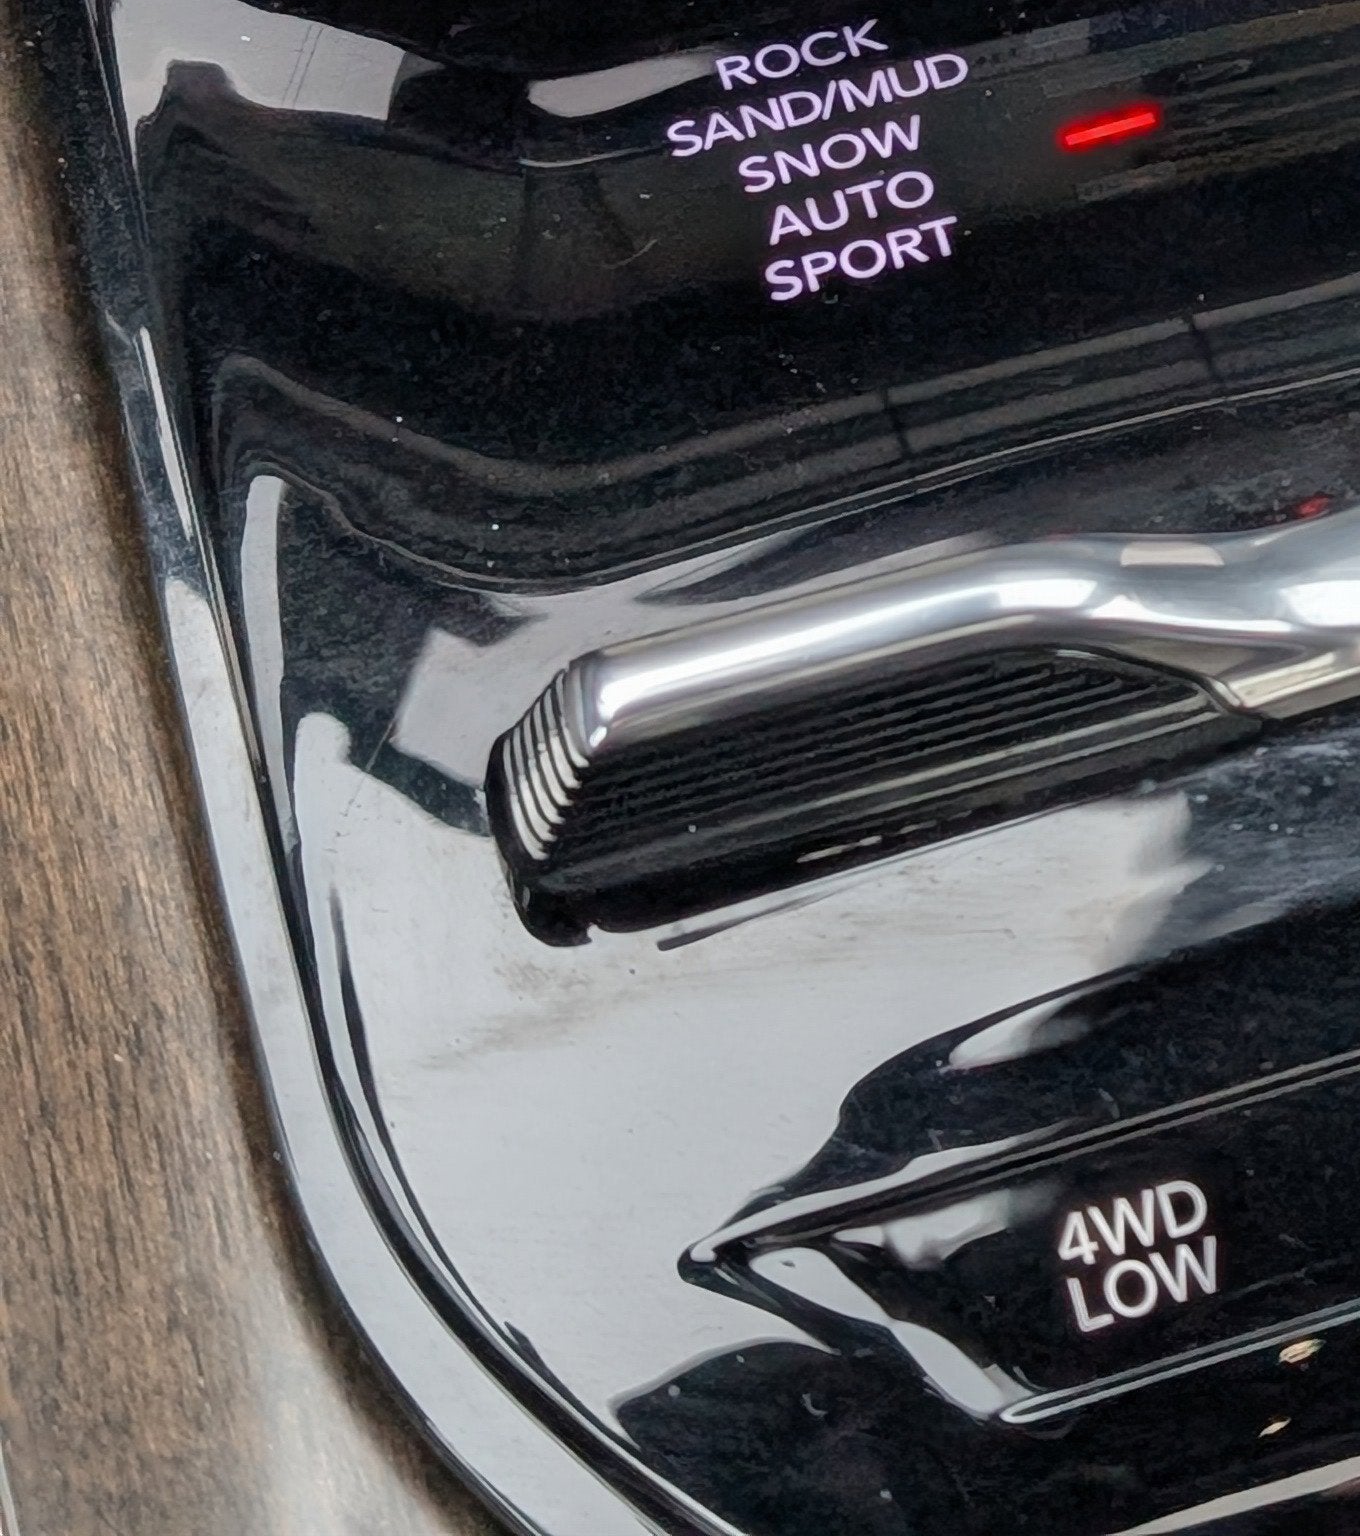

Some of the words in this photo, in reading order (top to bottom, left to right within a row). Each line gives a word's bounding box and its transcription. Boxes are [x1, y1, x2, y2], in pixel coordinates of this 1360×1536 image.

[717, 19, 888, 92] ROCK
[667, 53, 968, 158] SAND/MUD
[738, 114, 922, 194] SNOW
[769, 170, 934, 245] AUTO
[764, 216, 959, 302] SPORT
[1056, 1179, 1209, 1266] 4WD
[1066, 1234, 1220, 1332] LOW
